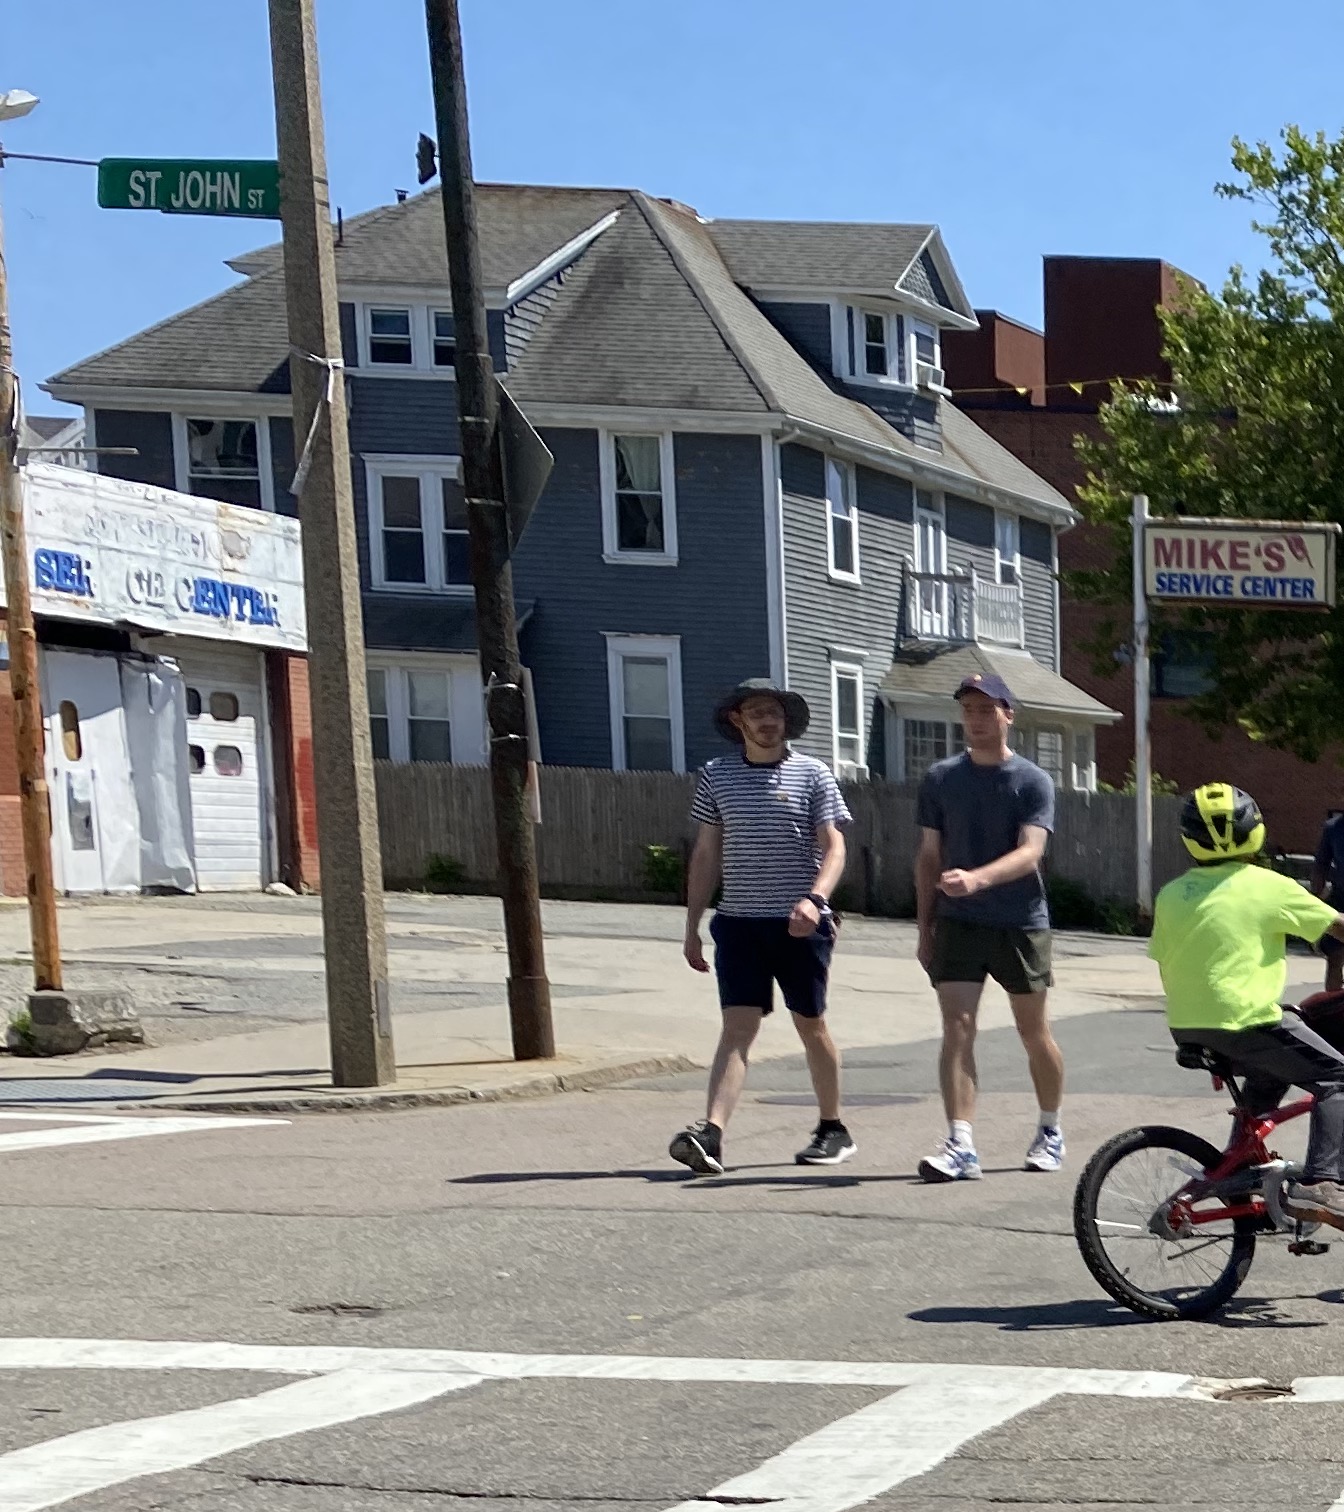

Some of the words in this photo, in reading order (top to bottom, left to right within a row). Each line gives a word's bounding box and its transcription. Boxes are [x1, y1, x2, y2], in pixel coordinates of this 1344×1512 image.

[128, 169, 162, 207] ST
[171, 170, 240, 209] JOHN
[247, 189, 265, 209] ST
[1153, 537, 1287, 573] MIKE'S
[1156, 573, 1234, 596] SERVICE
[1240, 576, 1316, 599] CENTER
